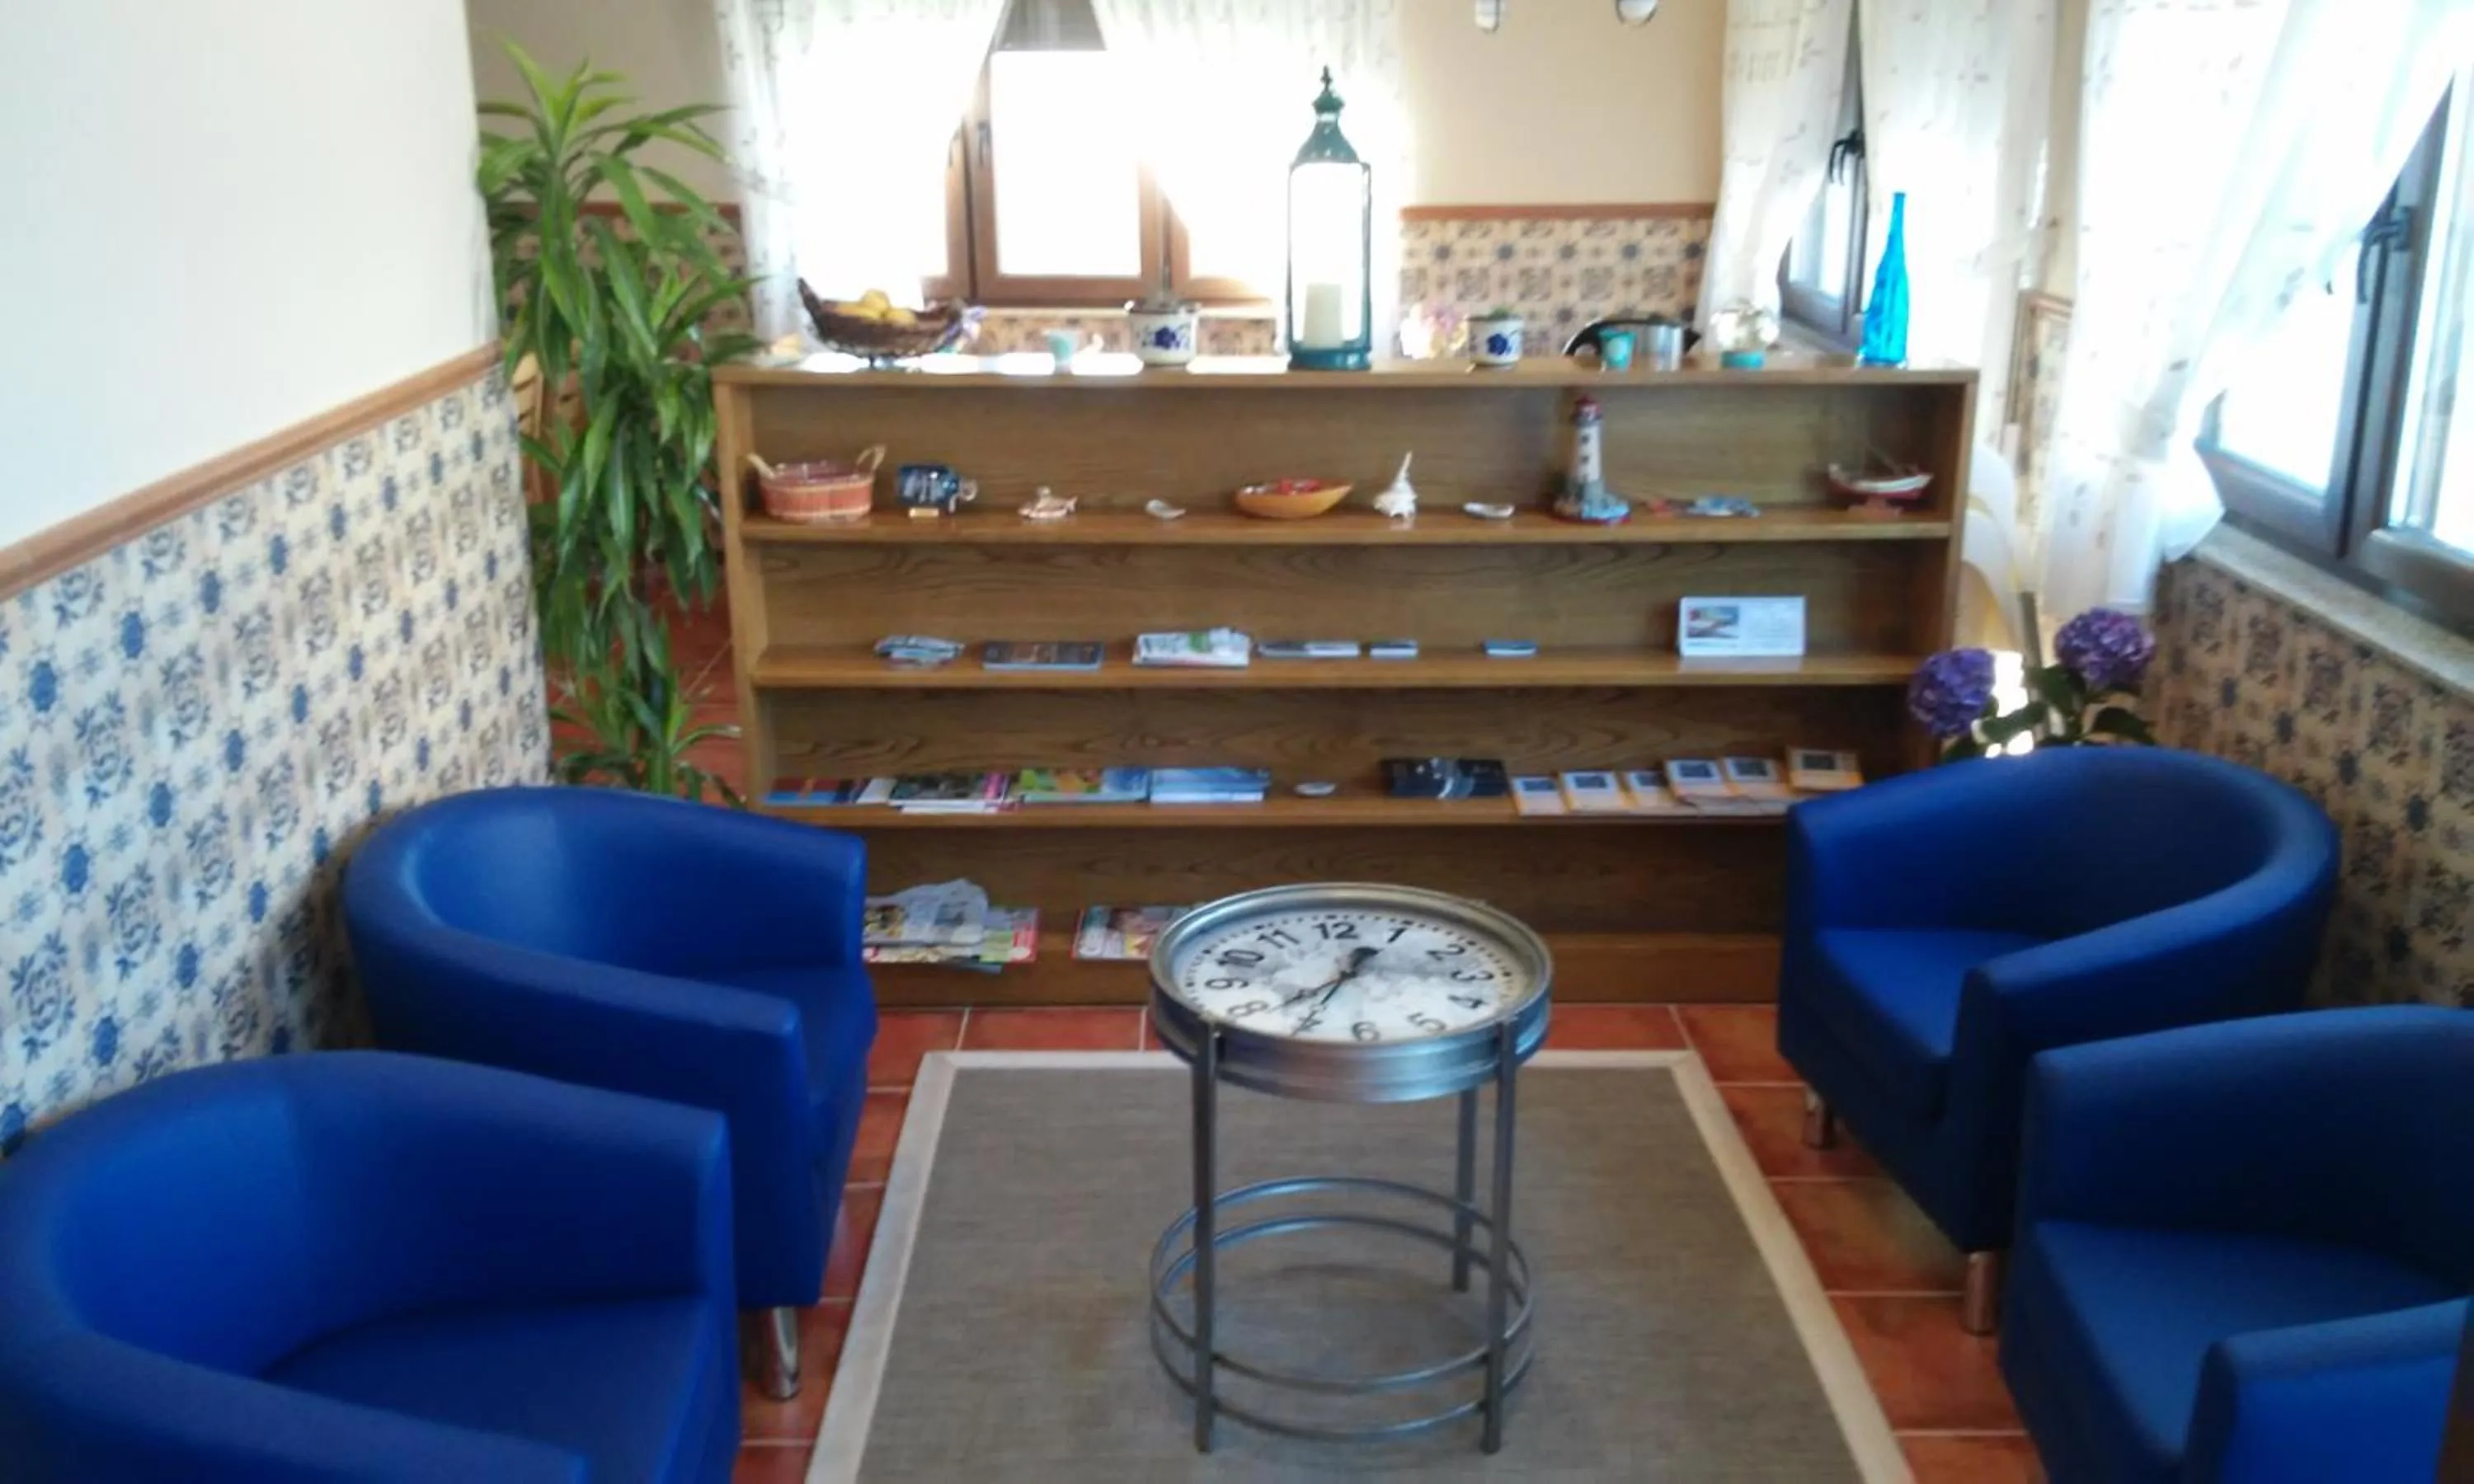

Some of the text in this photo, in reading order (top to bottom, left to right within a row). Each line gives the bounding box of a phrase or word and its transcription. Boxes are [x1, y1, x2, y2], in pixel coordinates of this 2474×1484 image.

[1257, 929, 1300, 949] 11
[1310, 922, 1360, 940] 12
[1388, 927, 1408, 944] 1
[1215, 949, 1265, 969] 10
[1426, 943, 1466, 961] 2
[1204, 978, 1249, 989] 9
[1450, 970, 1495, 982] 3
[1227, 1000, 1270, 1017] 8
[1447, 994, 1488, 1010] 4
[1352, 1021, 1381, 1042] 6
[1408, 1012, 1447, 1034] 5
